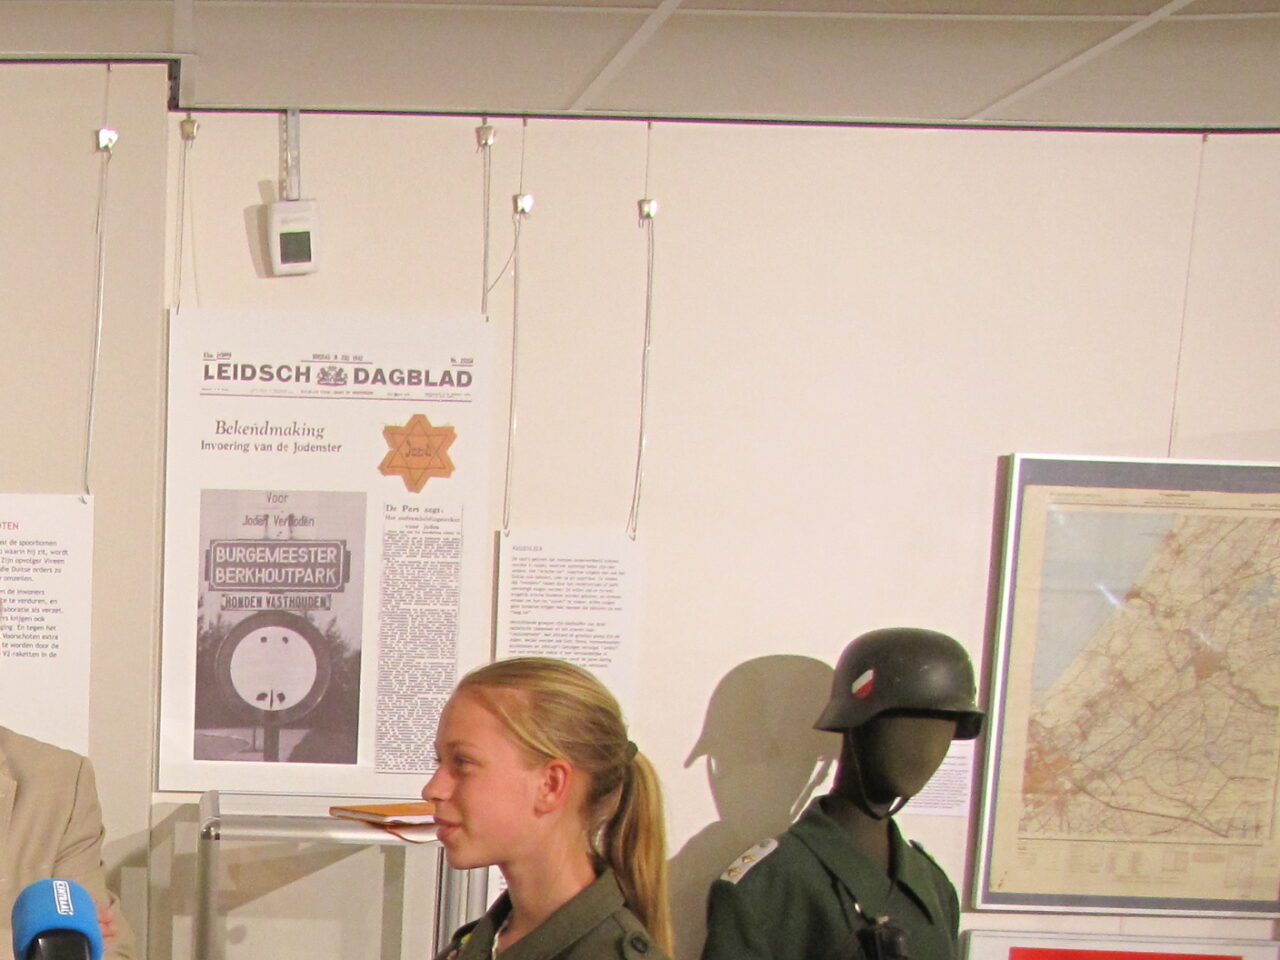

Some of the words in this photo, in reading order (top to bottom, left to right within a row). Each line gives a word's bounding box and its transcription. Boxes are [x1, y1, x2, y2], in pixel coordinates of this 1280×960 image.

[204, 364, 311, 383] LEIDSCH
[354, 368, 472, 387] DAGBLAD
[216, 420, 325, 439] Bekendmaking
[201, 440, 249, 453] Invoering
[277, 443, 288, 451] de
[293, 443, 342, 454] Jodenster
[267, 492, 288, 503] Voor
[216, 547, 337, 563] BURGEMEESTER
[215, 568, 336, 583] BERKHOUTPARK
[225, 596, 262, 608] HONDEN
[266, 595, 327, 609] VASTHOUDEN
